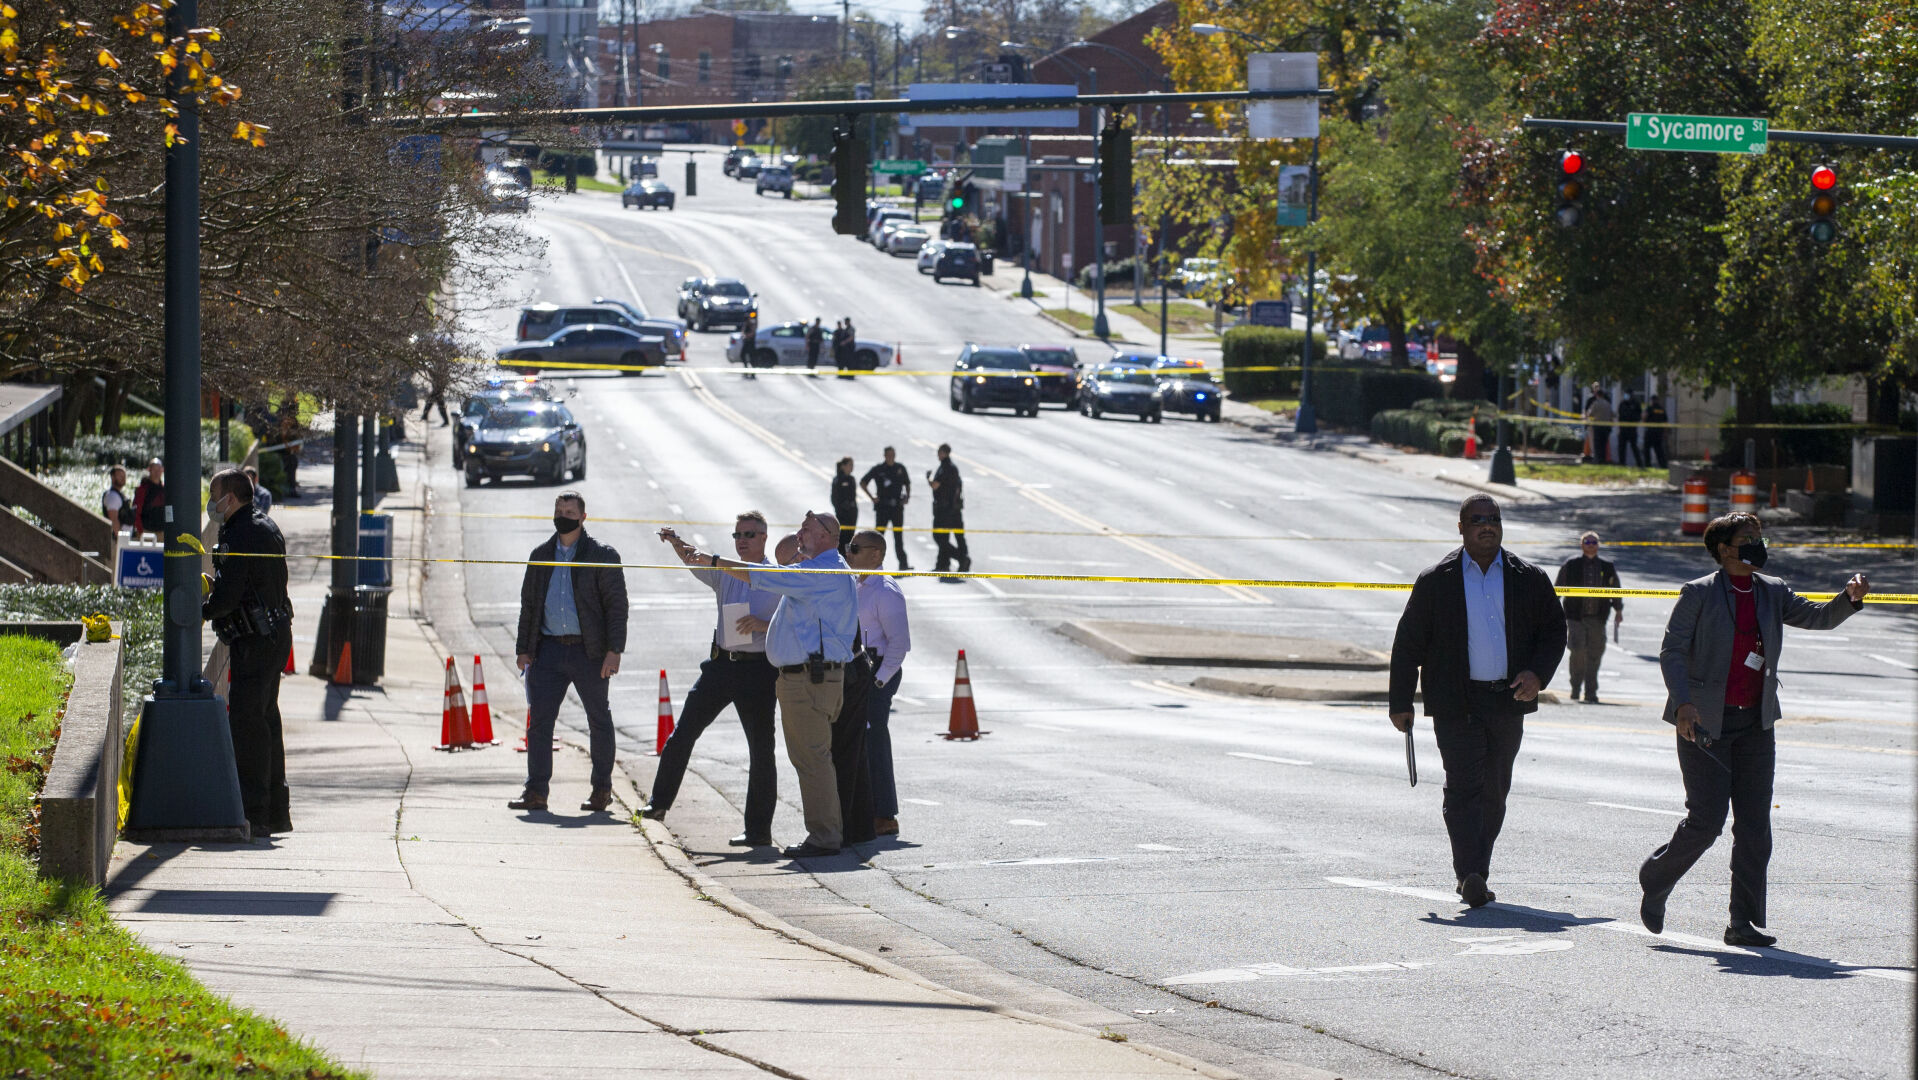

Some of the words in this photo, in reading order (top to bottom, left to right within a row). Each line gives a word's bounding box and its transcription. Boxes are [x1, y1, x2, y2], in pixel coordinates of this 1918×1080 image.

[1633, 116, 1642, 127] W
[1647, 116, 1745, 144] Sycamore
[1752, 120, 1763, 131] St
[1748, 142, 1766, 153] 400
[122, 576, 164, 588] HANDICAPPE
